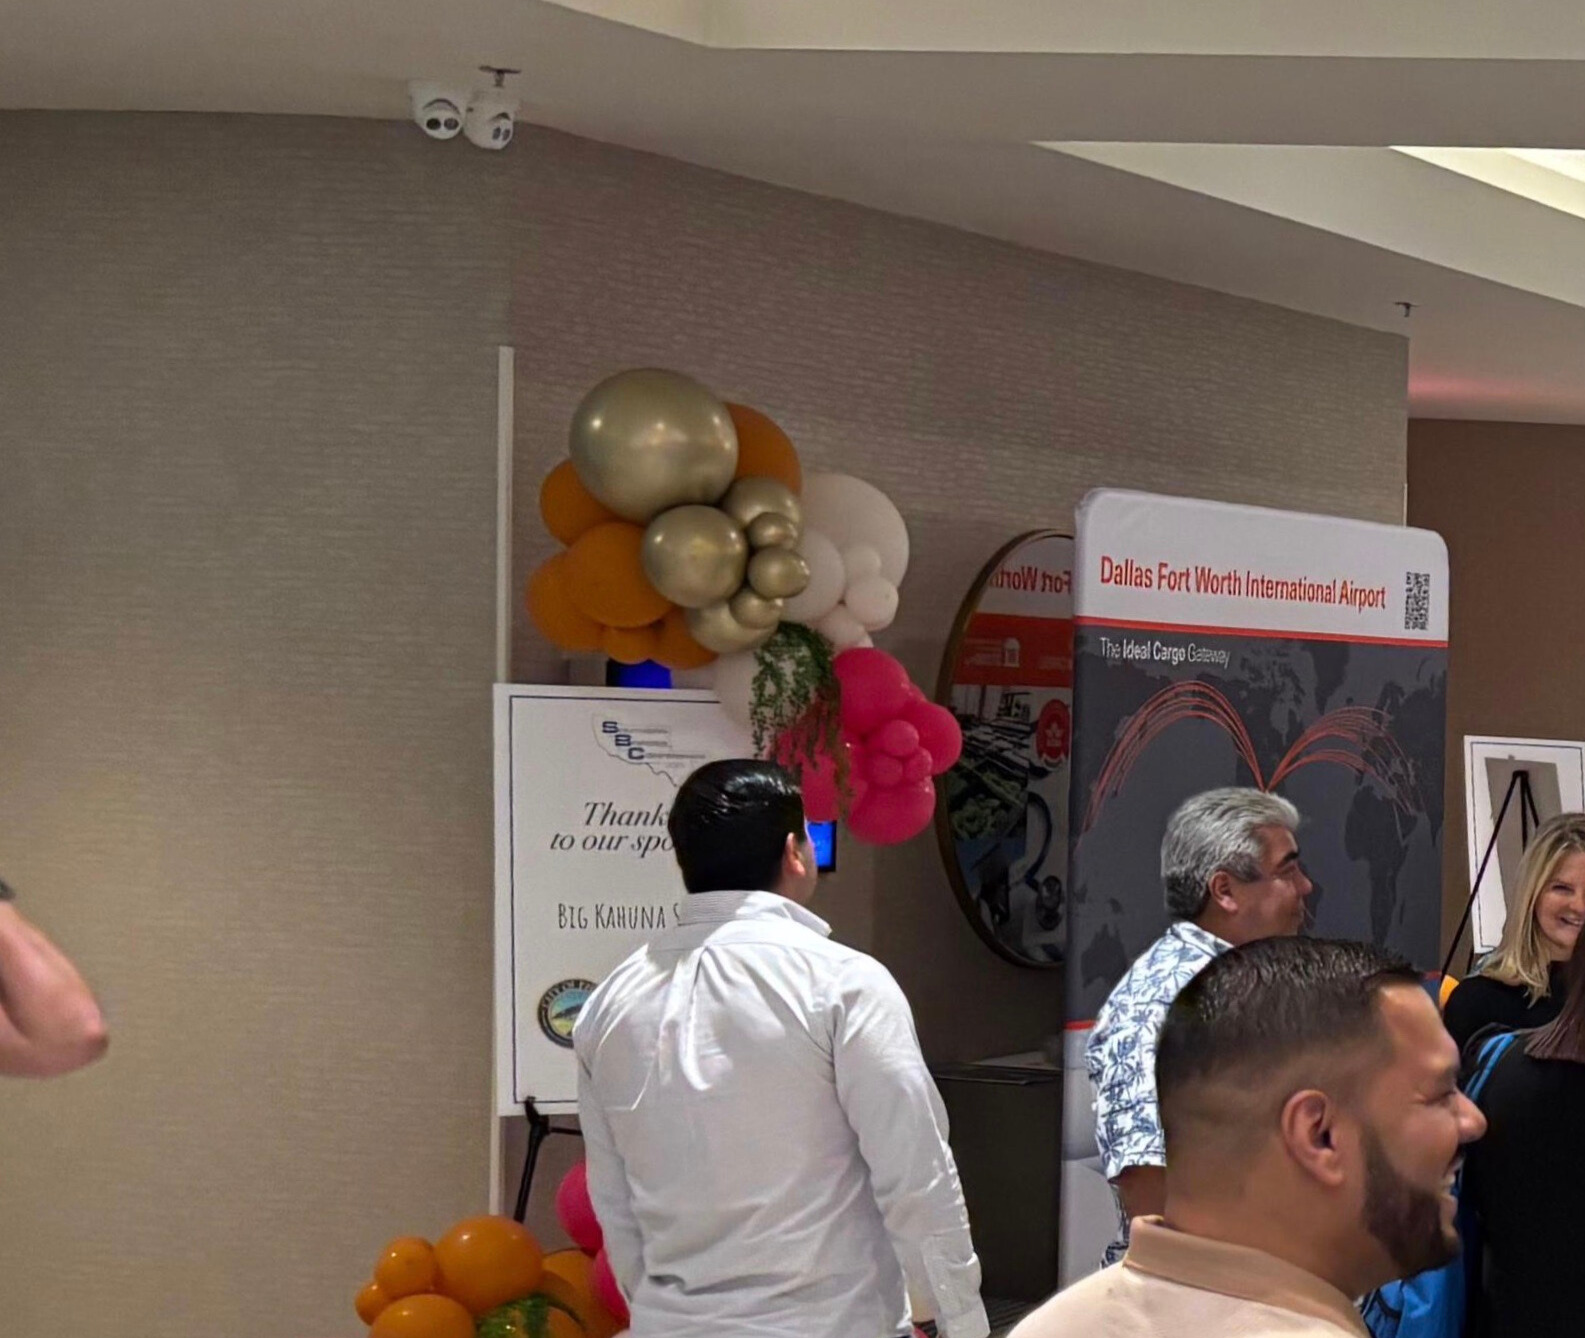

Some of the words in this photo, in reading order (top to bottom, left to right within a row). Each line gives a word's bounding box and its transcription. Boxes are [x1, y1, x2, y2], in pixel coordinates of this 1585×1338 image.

[1100, 556, 1153, 589] Dallas
[1157, 562, 1190, 593] Fort
[1195, 566, 1242, 597] Worth
[1246, 571, 1337, 604] International
[1339, 580, 1386, 614] Airport
[1100, 637, 1121, 658] The
[1123, 639, 1151, 660] Ideal
[1153, 640, 1186, 665] Cargo
[1187, 643, 1231, 669] Gateway
[584, 801, 669, 827] Thank
[550, 832, 575, 850] to
[582, 835, 628, 851] our
[558, 903, 588, 930] BIG
[595, 903, 666, 930] KAHUNA
